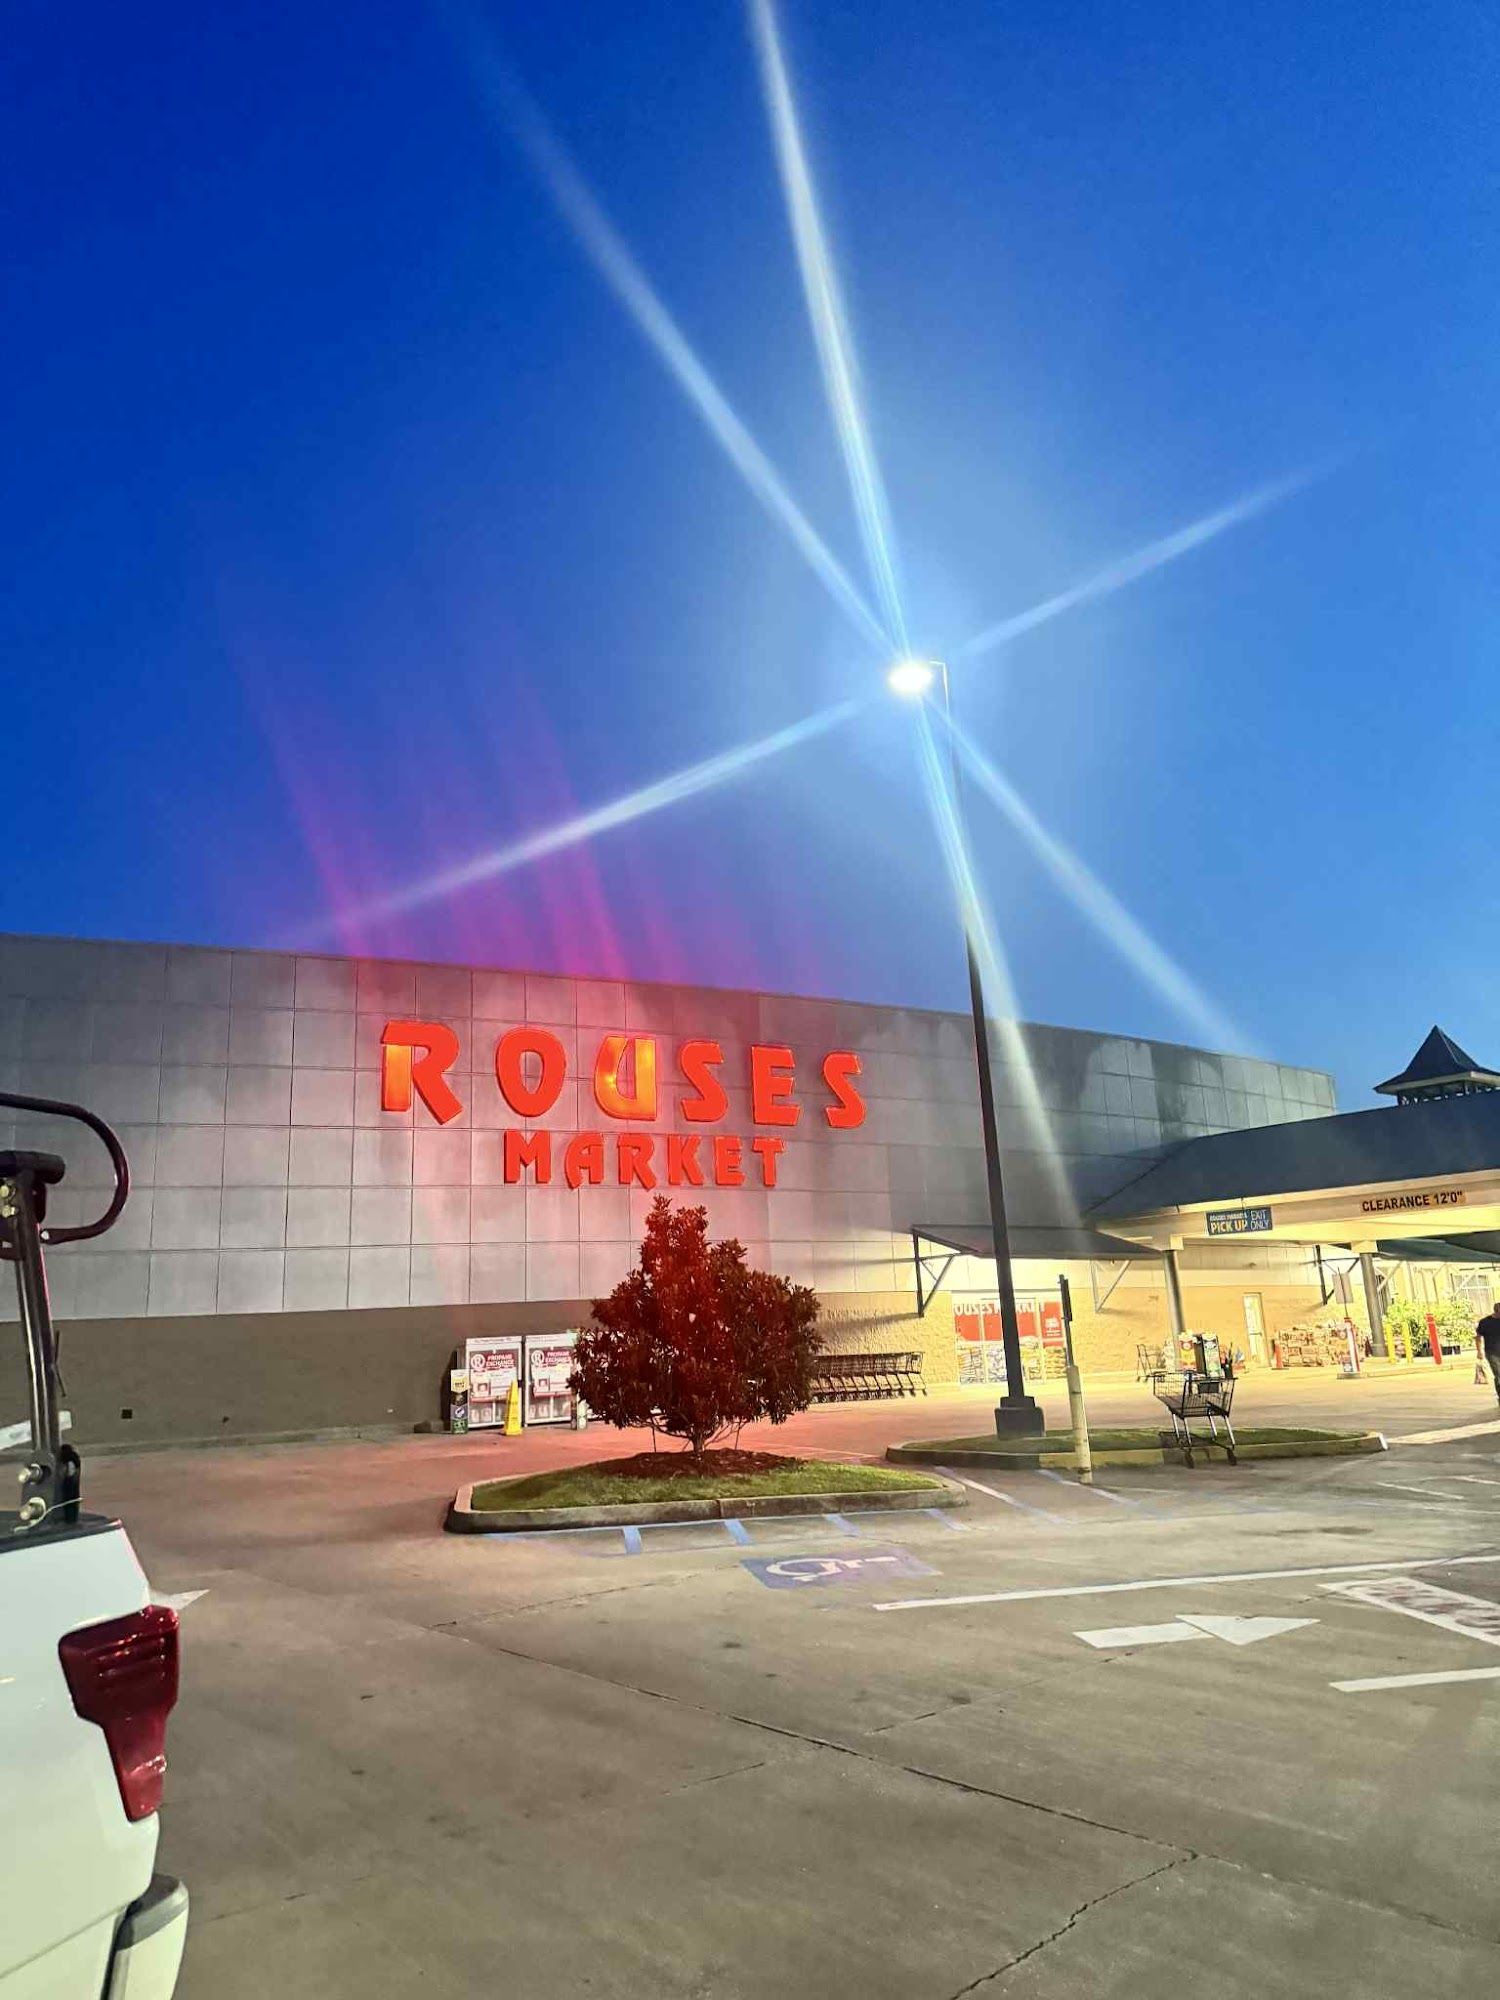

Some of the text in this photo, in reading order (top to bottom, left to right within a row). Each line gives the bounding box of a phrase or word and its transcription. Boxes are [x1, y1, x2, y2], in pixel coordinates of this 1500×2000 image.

[380, 1020, 867, 1129] ROUSES
[503, 1129, 786, 1191] MARKET
[1362, 1191, 1463, 1213] CLEARANCE 12'0"
[1250, 1209, 1267, 1220] EXIT
[1210, 1219, 1248, 1234] PICK UP
[1250, 1219, 1269, 1230] ONLY
